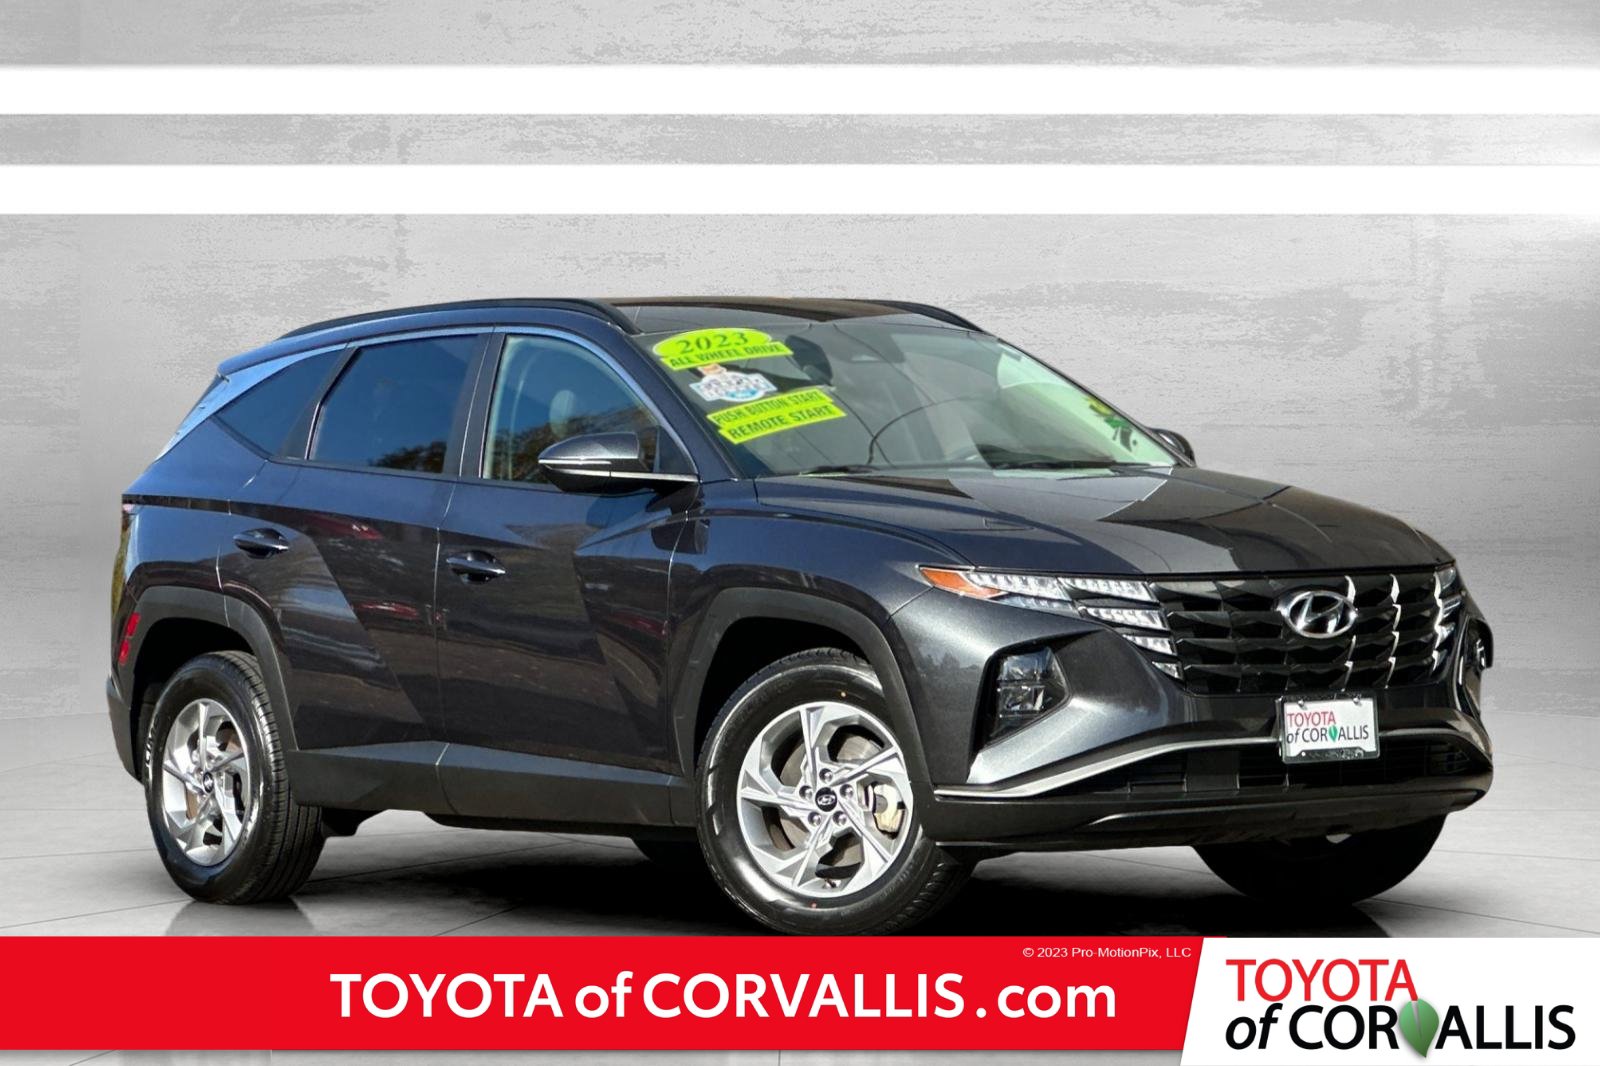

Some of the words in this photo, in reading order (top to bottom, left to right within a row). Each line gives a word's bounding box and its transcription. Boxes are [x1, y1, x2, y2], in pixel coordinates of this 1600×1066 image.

[676, 332, 748, 354] 2023
[670, 356, 692, 367] ALL
[698, 349, 740, 361] WHEEL
[744, 343, 782, 354] DRIVE
[713, 408, 745, 423] PUSH
[748, 399, 789, 415] BUTTON
[790, 391, 824, 405] START
[730, 416, 785, 438] REMOTE
[791, 405, 833, 422] START
[1287, 711, 1336, 727] TOYOTA
[1286, 728, 1300, 744] of
